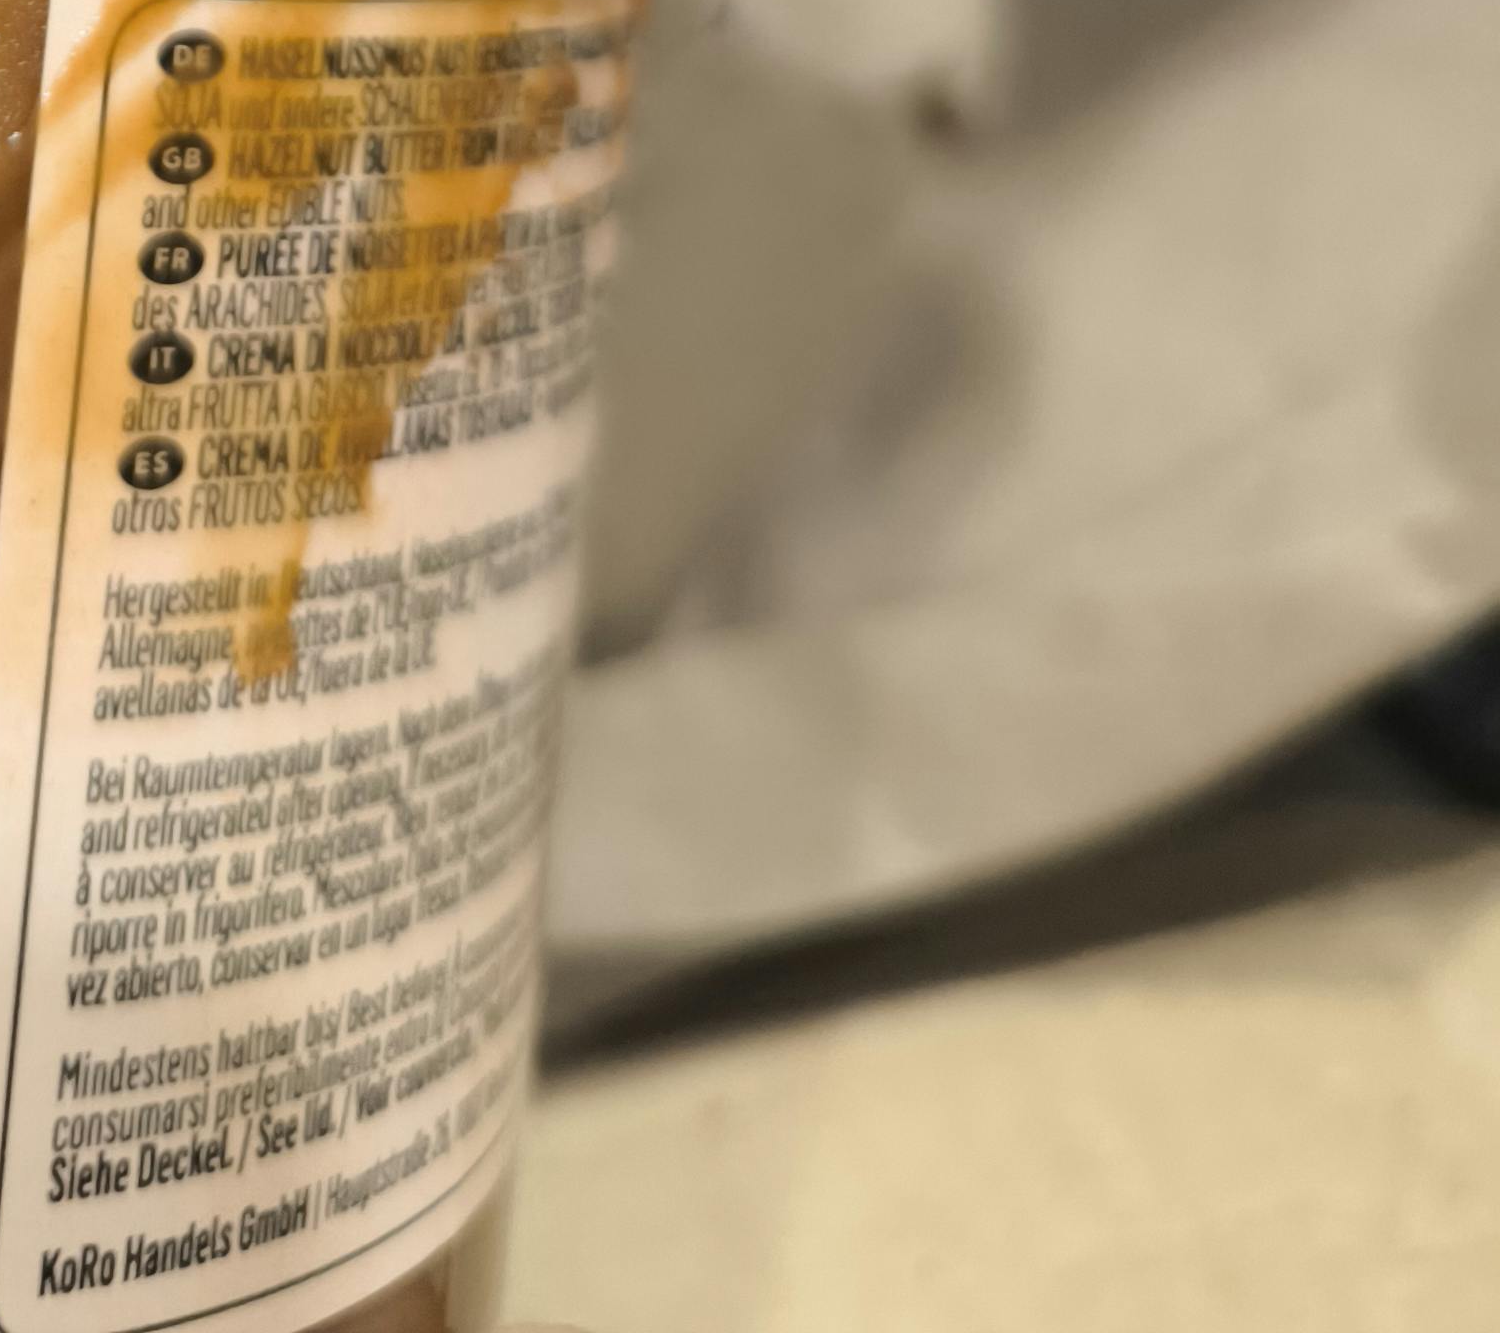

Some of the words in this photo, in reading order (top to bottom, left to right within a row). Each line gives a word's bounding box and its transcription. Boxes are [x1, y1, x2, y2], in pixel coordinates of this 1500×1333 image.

[172, 43, 213, 70] DE
[161, 145, 202, 170] GB
[141, 183, 190, 230] and
[195, 185, 263, 230] other
[265, 181, 342, 229] EDIBLE
[152, 245, 192, 272] FR
[216, 229, 302, 280] PURÉE
[307, 229, 341, 276] DE
[132, 285, 178, 331] des
[207, 332, 295, 379] CREMA
[305, 330, 328, 372] DI
[121, 385, 182, 433] altra
[186, 380, 281, 431] FRUTTA
[286, 378, 303, 426] A
[133, 450, 170, 475] ES
[197, 428, 290, 480] CREMA
[298, 424, 327, 471] DE
[111, 490, 182, 536] otros
[187, 479, 287, 530] FRUTOS
[102, 565, 243, 629] Hergestellt
[92, 669, 213, 722] avellanas
[217, 664, 243, 710] de
[85, 753, 128, 805] Bei
[131, 735, 327, 802] Raumtemperatur
[80, 804, 130, 855] and
[132, 784, 275, 853] refrigerated
[276, 774, 327, 829] after
[74, 855, 93, 907] à
[99, 854, 221, 905] conserver
[226, 850, 257, 887] au
[70, 907, 159, 965] riporre
[163, 900, 188, 947] in
[192, 880, 307, 946] frigorifero.
[67, 968, 109, 1010] vez
[113, 948, 206, 1002] abierto,
[209, 927, 316, 988] conservar
[317, 919, 343, 960] en
[56, 1046, 214, 1102] Mindestens
[215, 1019, 303, 1074] haltbar
[51, 1079, 213, 1153] consumarsi
[47, 1150, 131, 1204] Siehe
[255, 1112, 300, 1161] See
[37, 1243, 118, 1299] KoRo
[121, 1215, 234, 1284] Handels
[238, 1183, 312, 1253] GmbH
